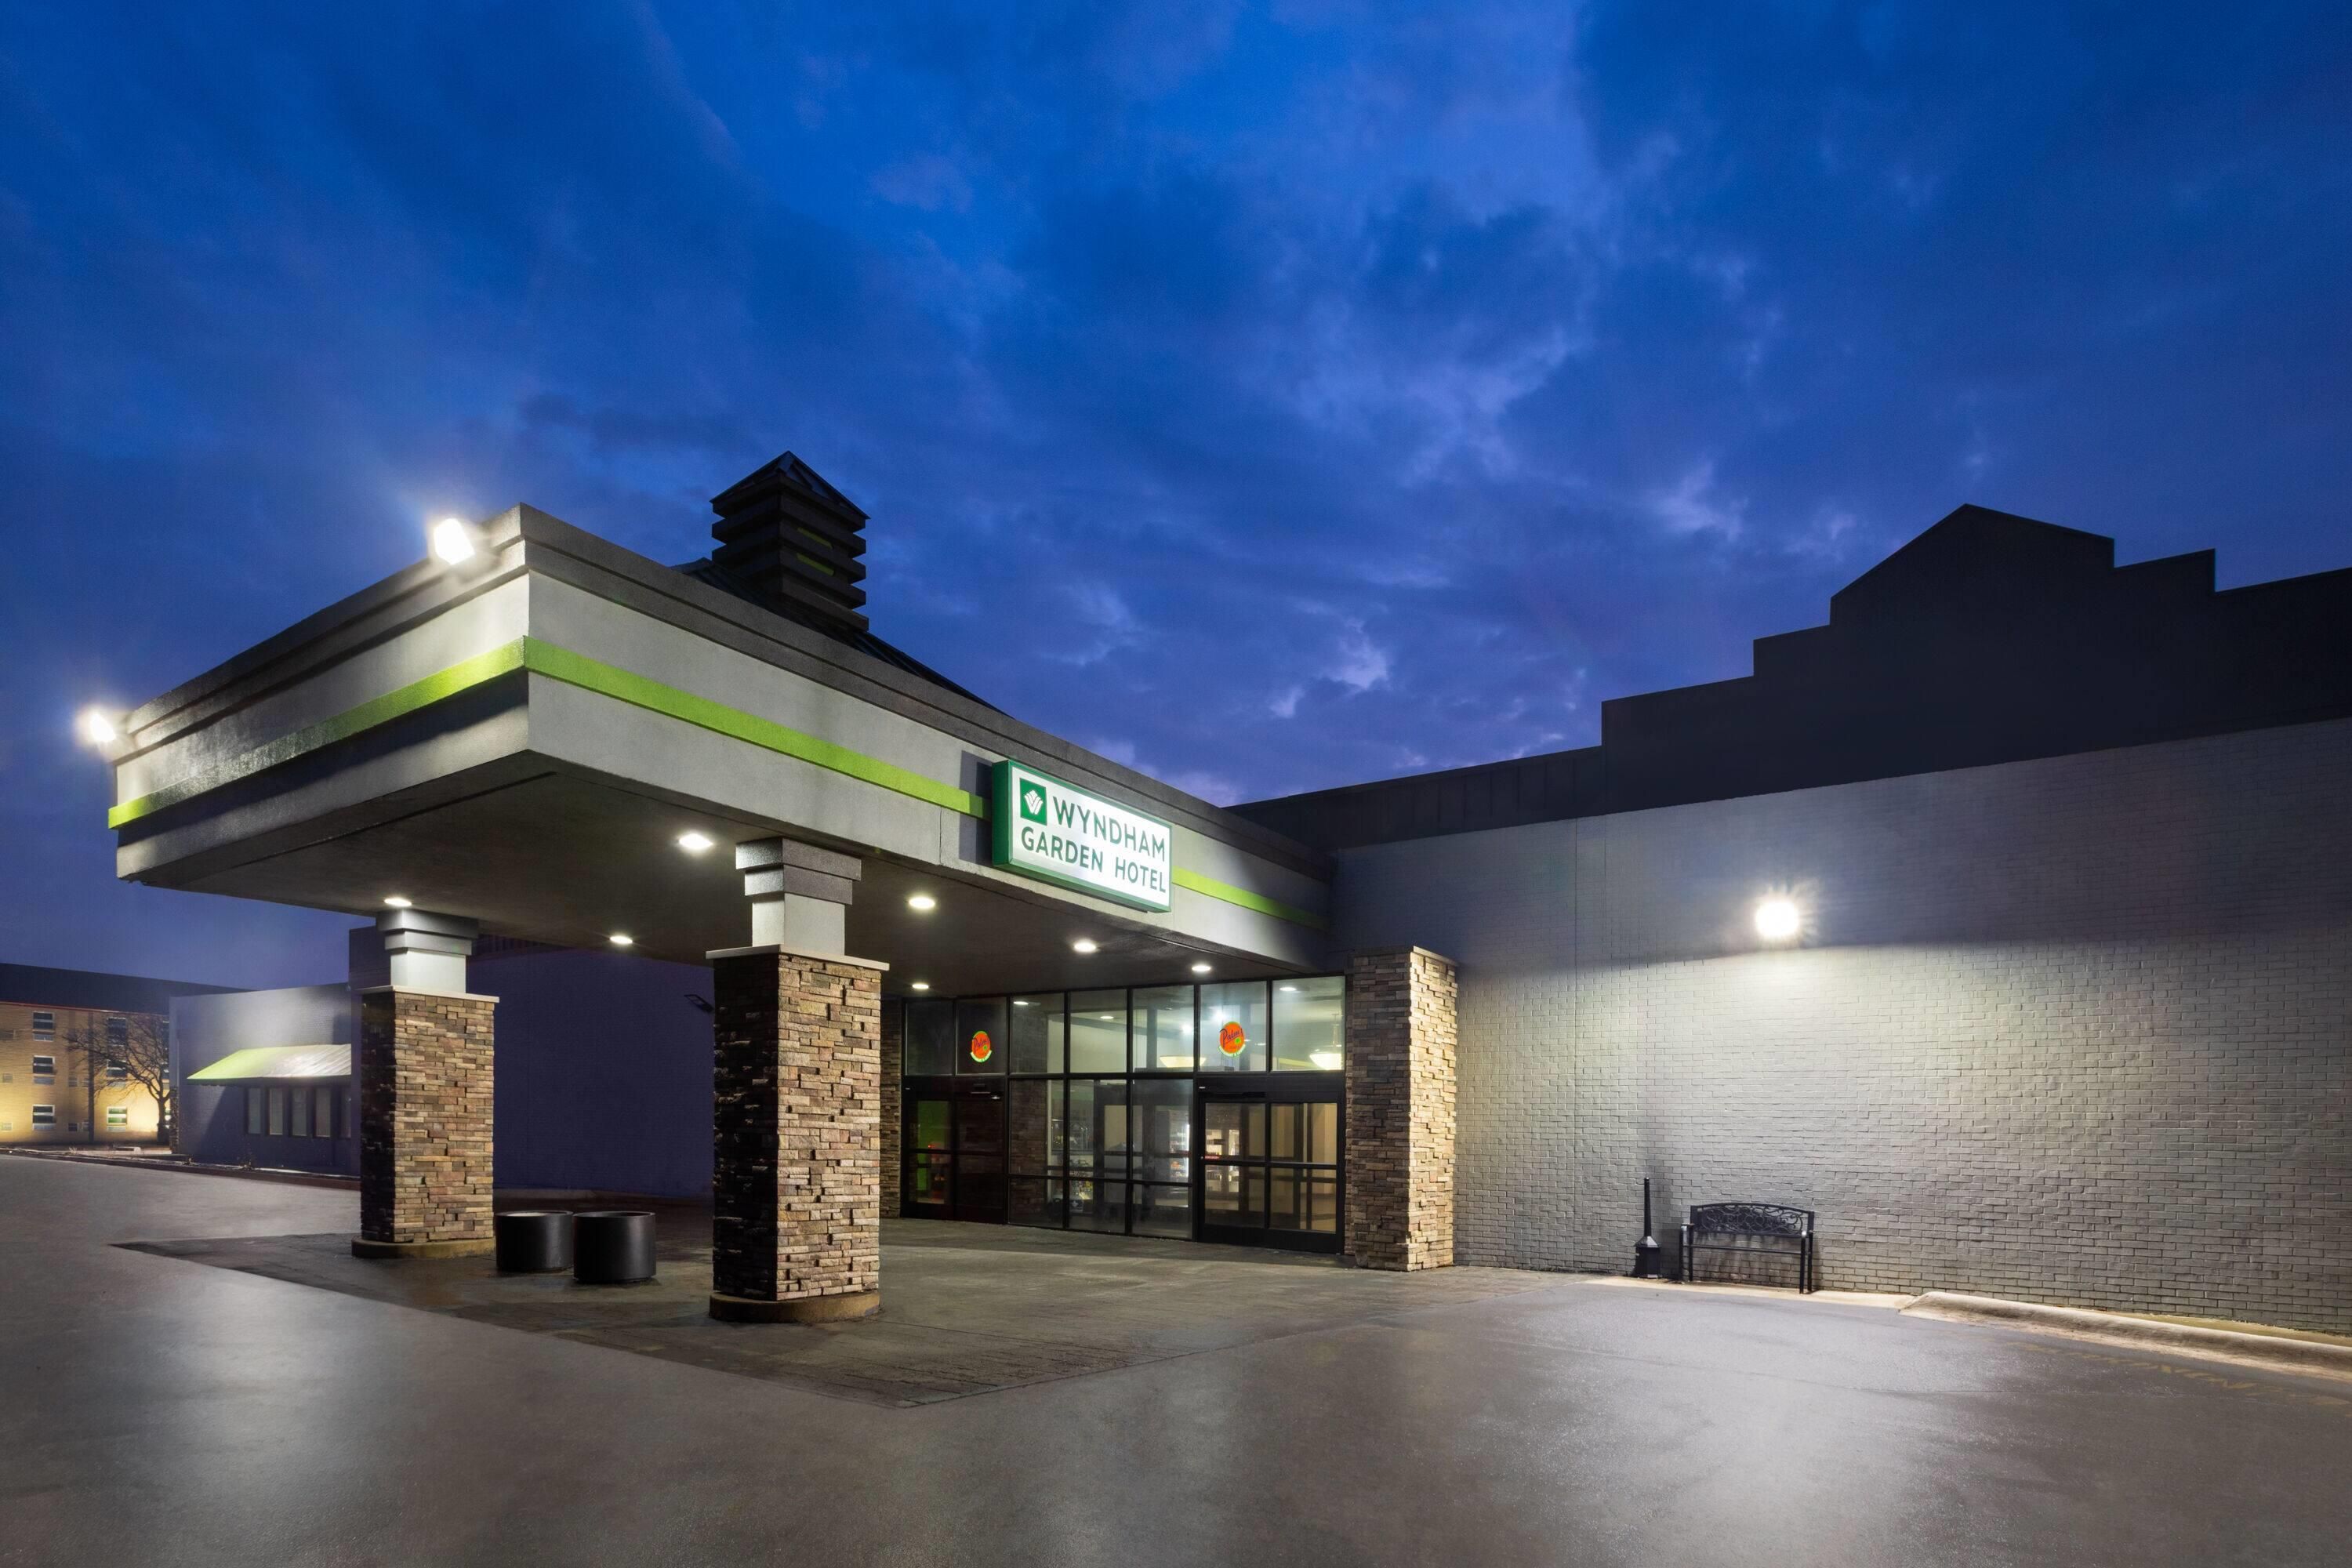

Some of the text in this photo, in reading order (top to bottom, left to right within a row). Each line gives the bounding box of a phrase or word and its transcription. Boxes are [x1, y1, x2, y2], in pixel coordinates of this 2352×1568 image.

[1021, 826, 1166, 893] GARDEN HOTEL
[1053, 796, 1165, 862] WYNDHAM
